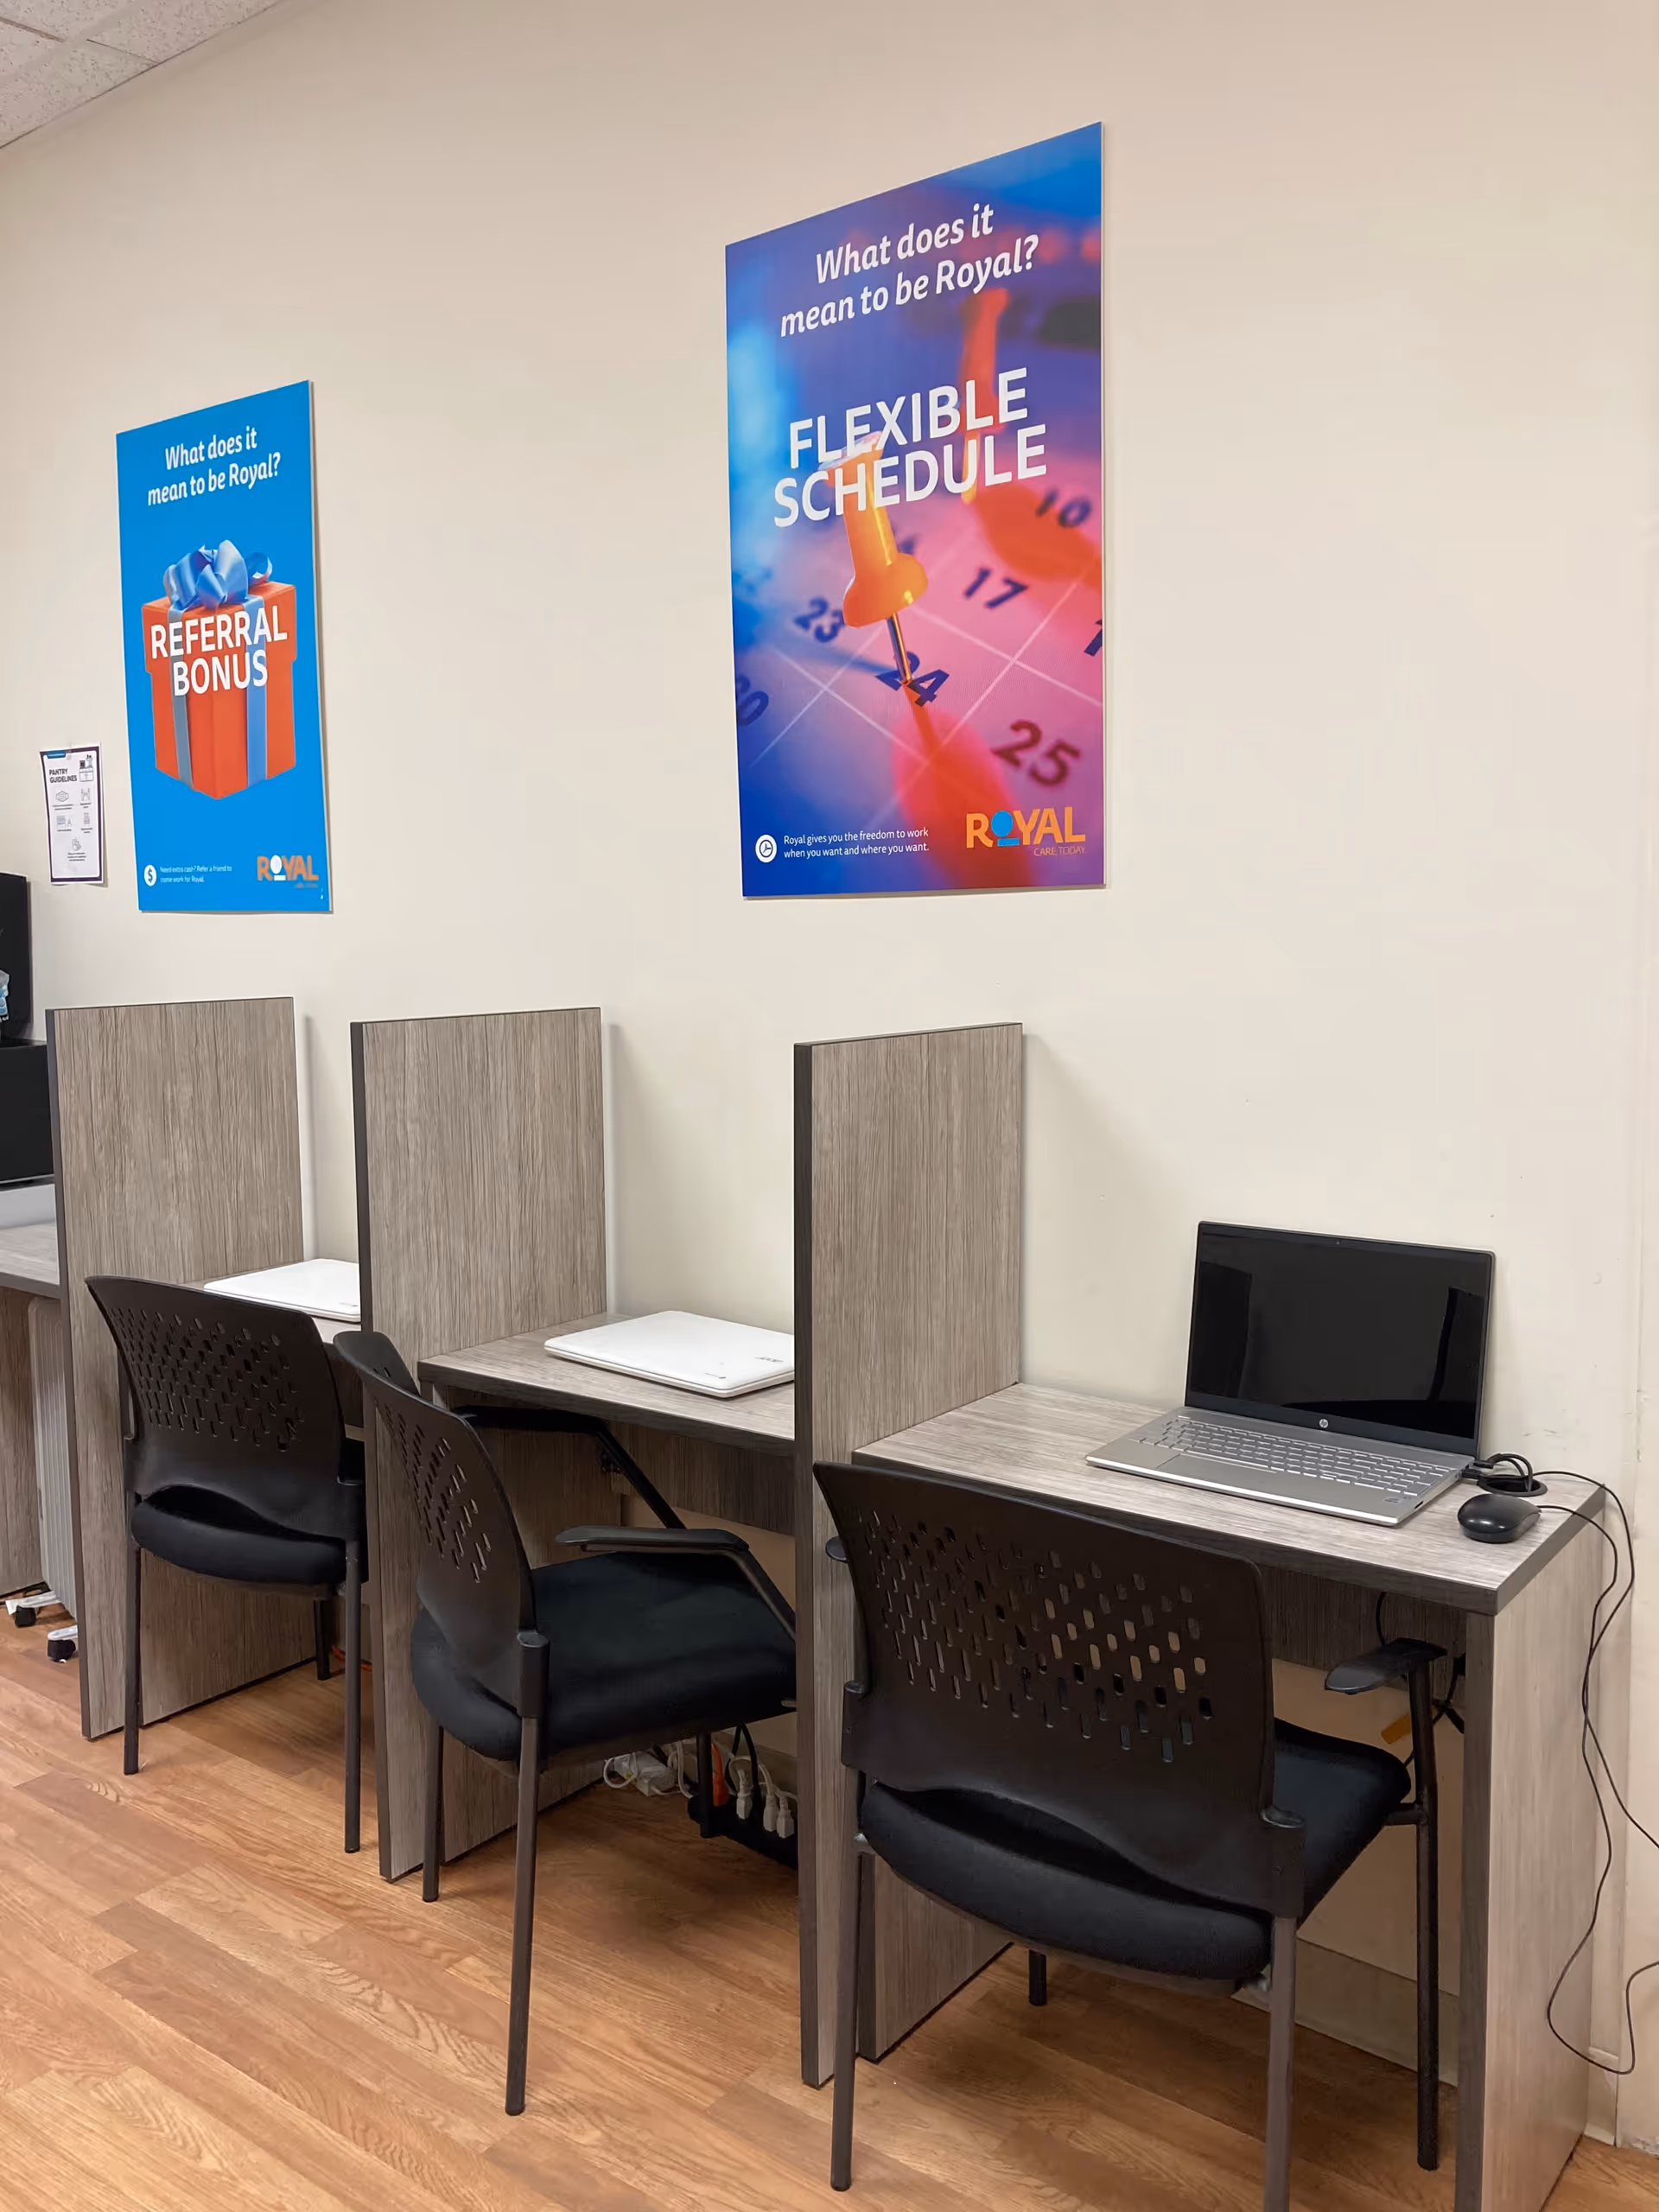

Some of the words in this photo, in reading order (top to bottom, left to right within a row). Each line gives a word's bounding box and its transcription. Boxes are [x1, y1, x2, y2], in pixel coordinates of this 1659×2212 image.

[816, 236, 891, 283] What
[897, 218, 964, 261] does
[971, 203, 994, 238] it
[780, 292, 855, 337] mean
[861, 284, 889, 312] to
[895, 271, 929, 306] be
[936, 234, 1039, 295] Royal?
[789, 366, 1028, 469] FLEXIBLE
[165, 442, 205, 470] What
[207, 434, 243, 461] does
[245, 426, 257, 448] it
[148, 480, 188, 506] mean
[189, 474, 206, 496] to
[207, 467, 226, 493] be
[228, 451, 281, 489] Royal?
[774, 423, 1047, 528] SCHEDULE
[964, 567, 1028, 609] 17
[150, 605, 288, 659] REFERRAL
[793, 596, 846, 643] 23
[173, 650, 268, 696] BONUS
[875, 652, 950, 708] 24
[989, 719, 1080, 788] 25
[49, 774, 78, 784] GUIDELINES
[784, 835, 805, 847] Royal
[807, 833, 827, 846] gives
[828, 834, 842, 844] you
[844, 831, 858, 842] the
[860, 830, 895, 841] freedom
[896, 830, 906, 838] to
[906, 827, 929, 837] work
[784, 849, 805, 858] when
[806, 849, 822, 859] you
[823, 847, 842, 856] want
[844, 845, 859, 855] and
[861, 843, 887, 854] where
[887, 844, 904, 855] you
[906, 842, 929, 852] want.
[966, 806, 1086, 849] ROYAL
[257, 855, 320, 881] ROYAL
[1033, 848, 1057, 856] CARE
